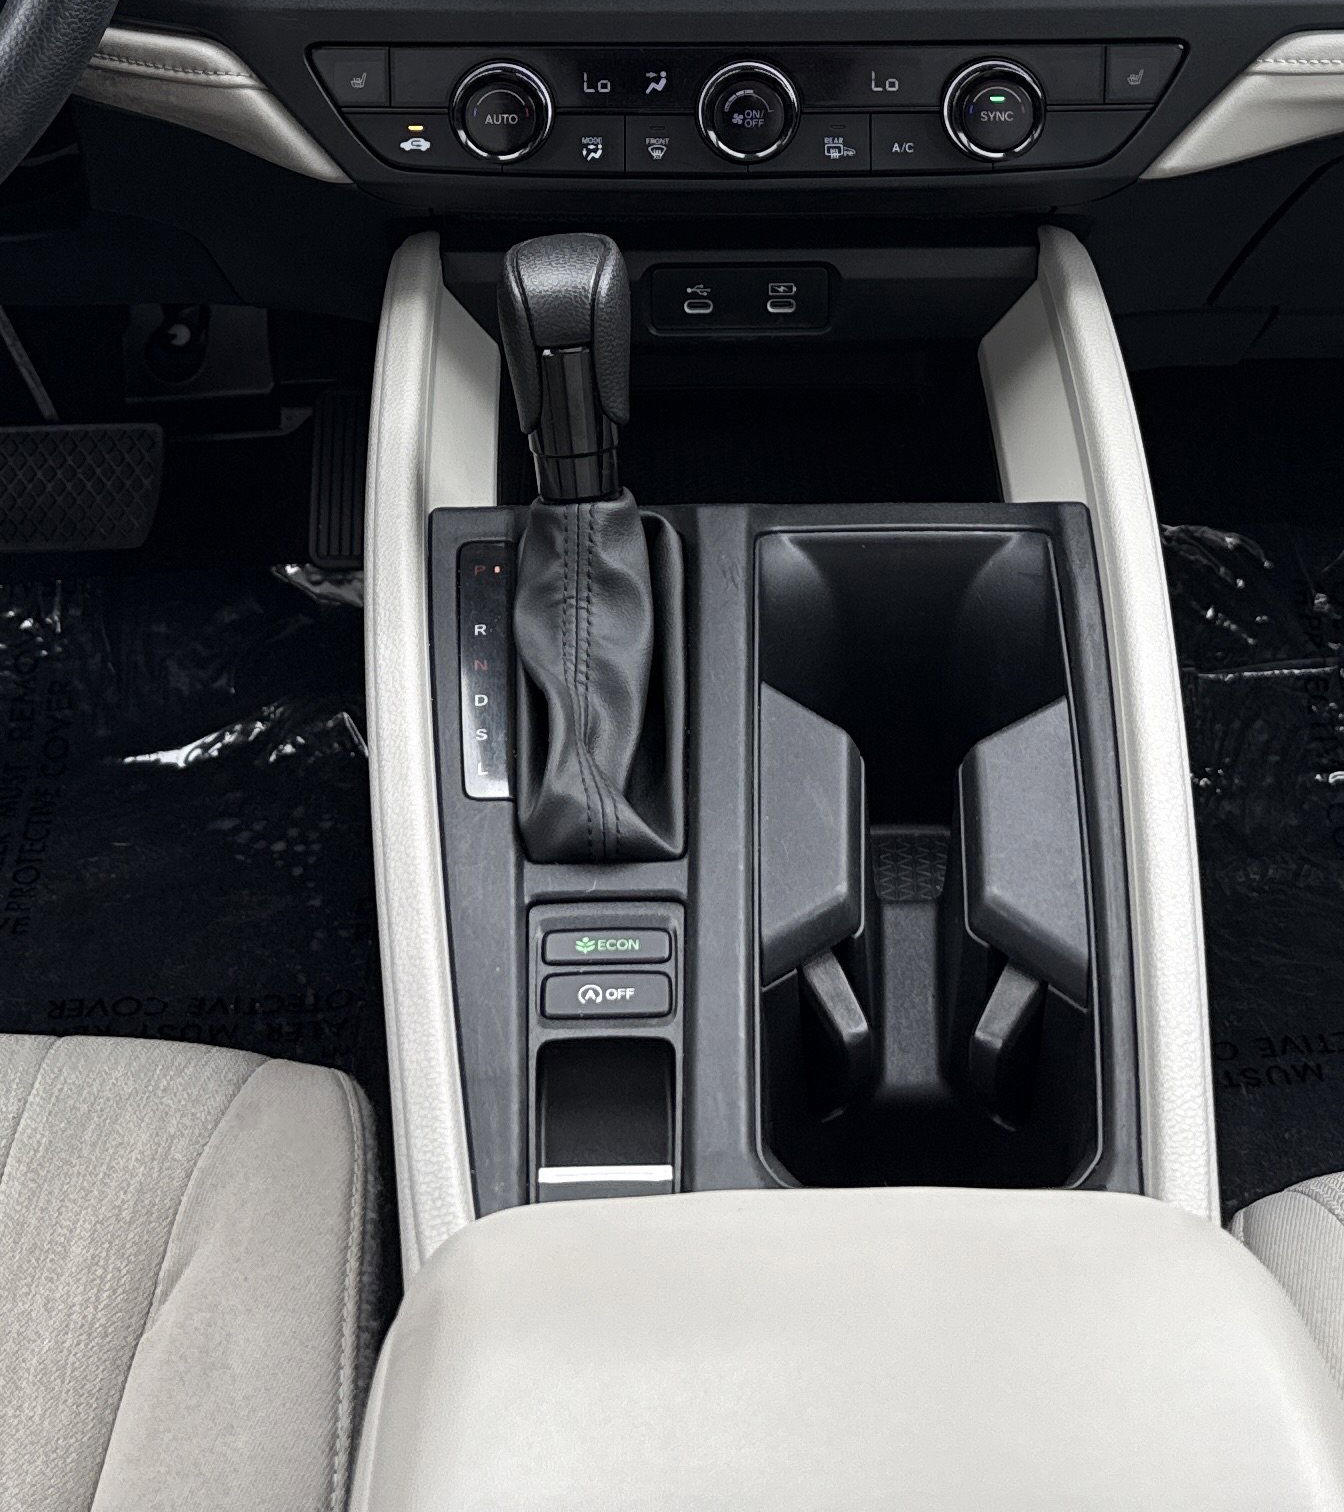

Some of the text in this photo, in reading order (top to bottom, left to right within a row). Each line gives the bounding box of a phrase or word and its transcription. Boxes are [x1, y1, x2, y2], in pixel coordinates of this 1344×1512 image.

[583, 71, 611, 93] Lo
[871, 71, 899, 92] Lo
[484, 113, 519, 125] AUTO
[743, 109, 765, 119] ON/
[980, 110, 1014, 122] SYNC
[743, 119, 765, 128] OFF
[581, 136, 603, 145] MODE
[645, 137, 670, 146] FRONT
[824, 136, 844, 144] REAR
[891, 142, 915, 154] A/C
[474, 564, 487, 577] P
[474, 623, 487, 636] R
[474, 659, 488, 671] N
[474, 694, 488, 707] D
[475, 728, 488, 741] S
[597, 938, 640, 951] ECON
[605, 987, 636, 1001] OFF
[47, 996, 169, 1020] COVER
